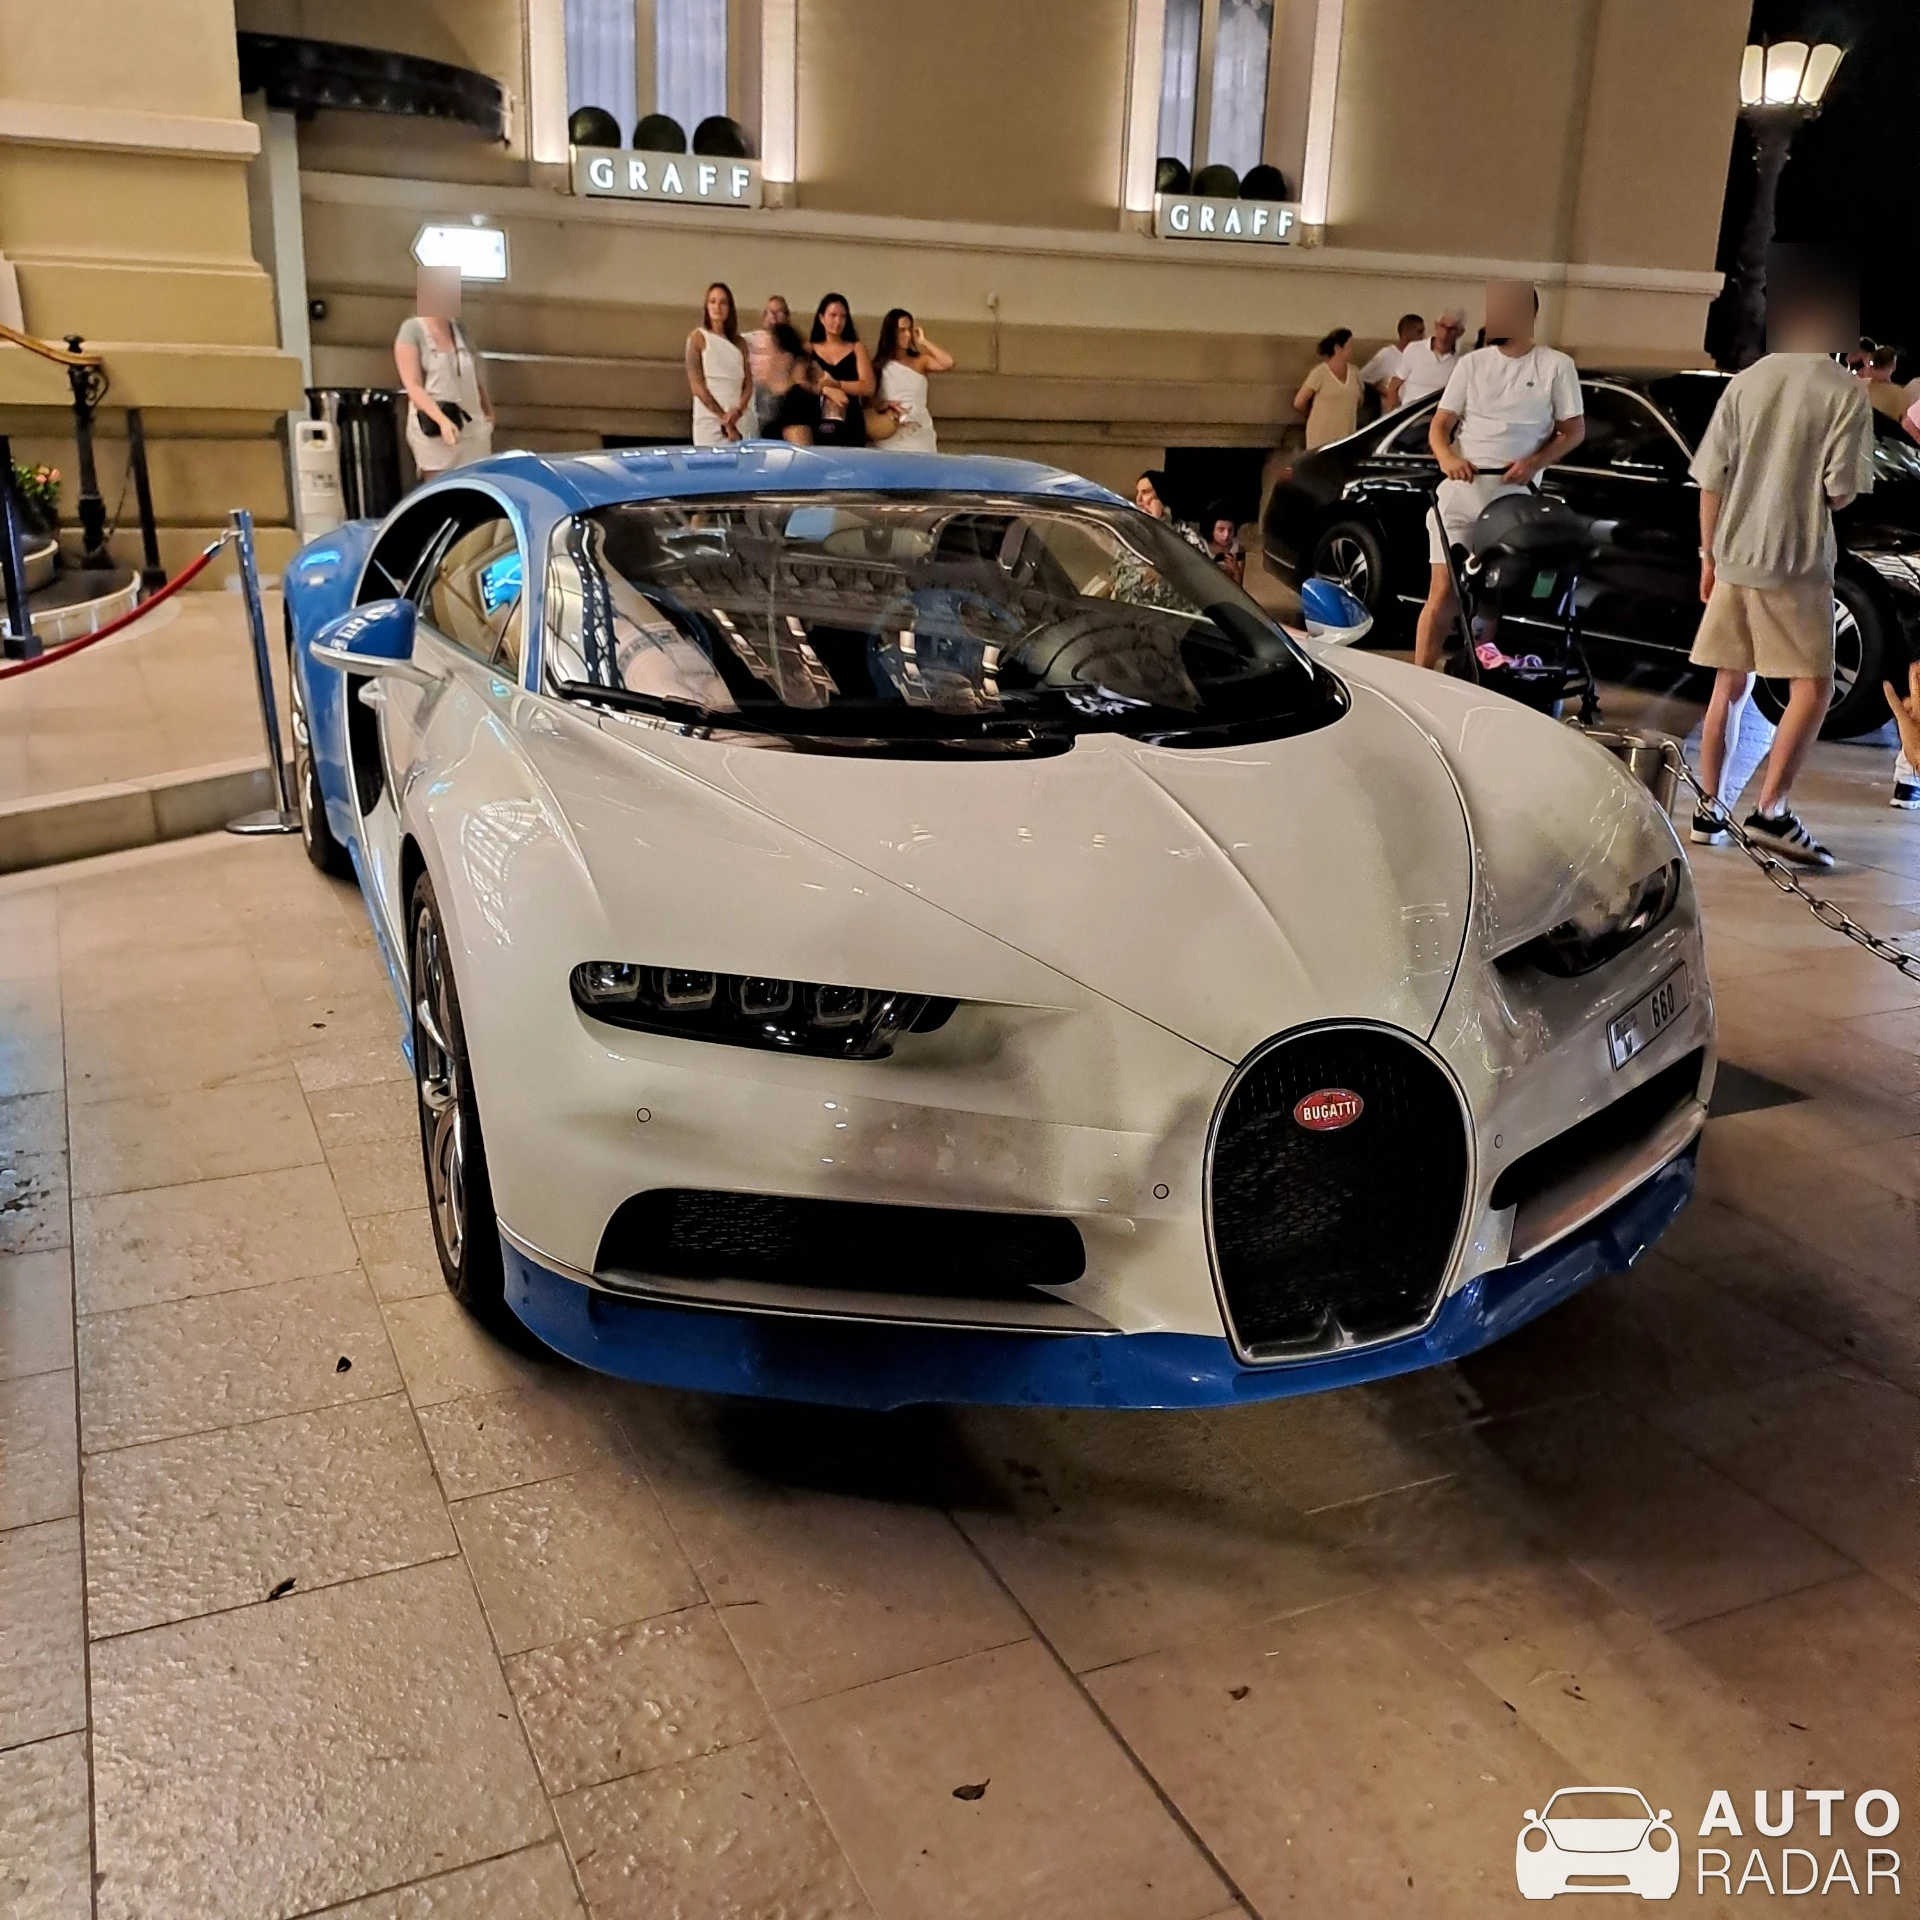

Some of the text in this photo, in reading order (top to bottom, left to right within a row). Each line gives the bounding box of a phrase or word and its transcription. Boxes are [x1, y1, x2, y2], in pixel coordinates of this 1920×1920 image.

[589, 157, 750, 198] GRAFF
[1170, 204, 1294, 237] GRAFF
[1651, 983, 1675, 1028] 660
[1303, 1101, 1356, 1121] BUGATTI
